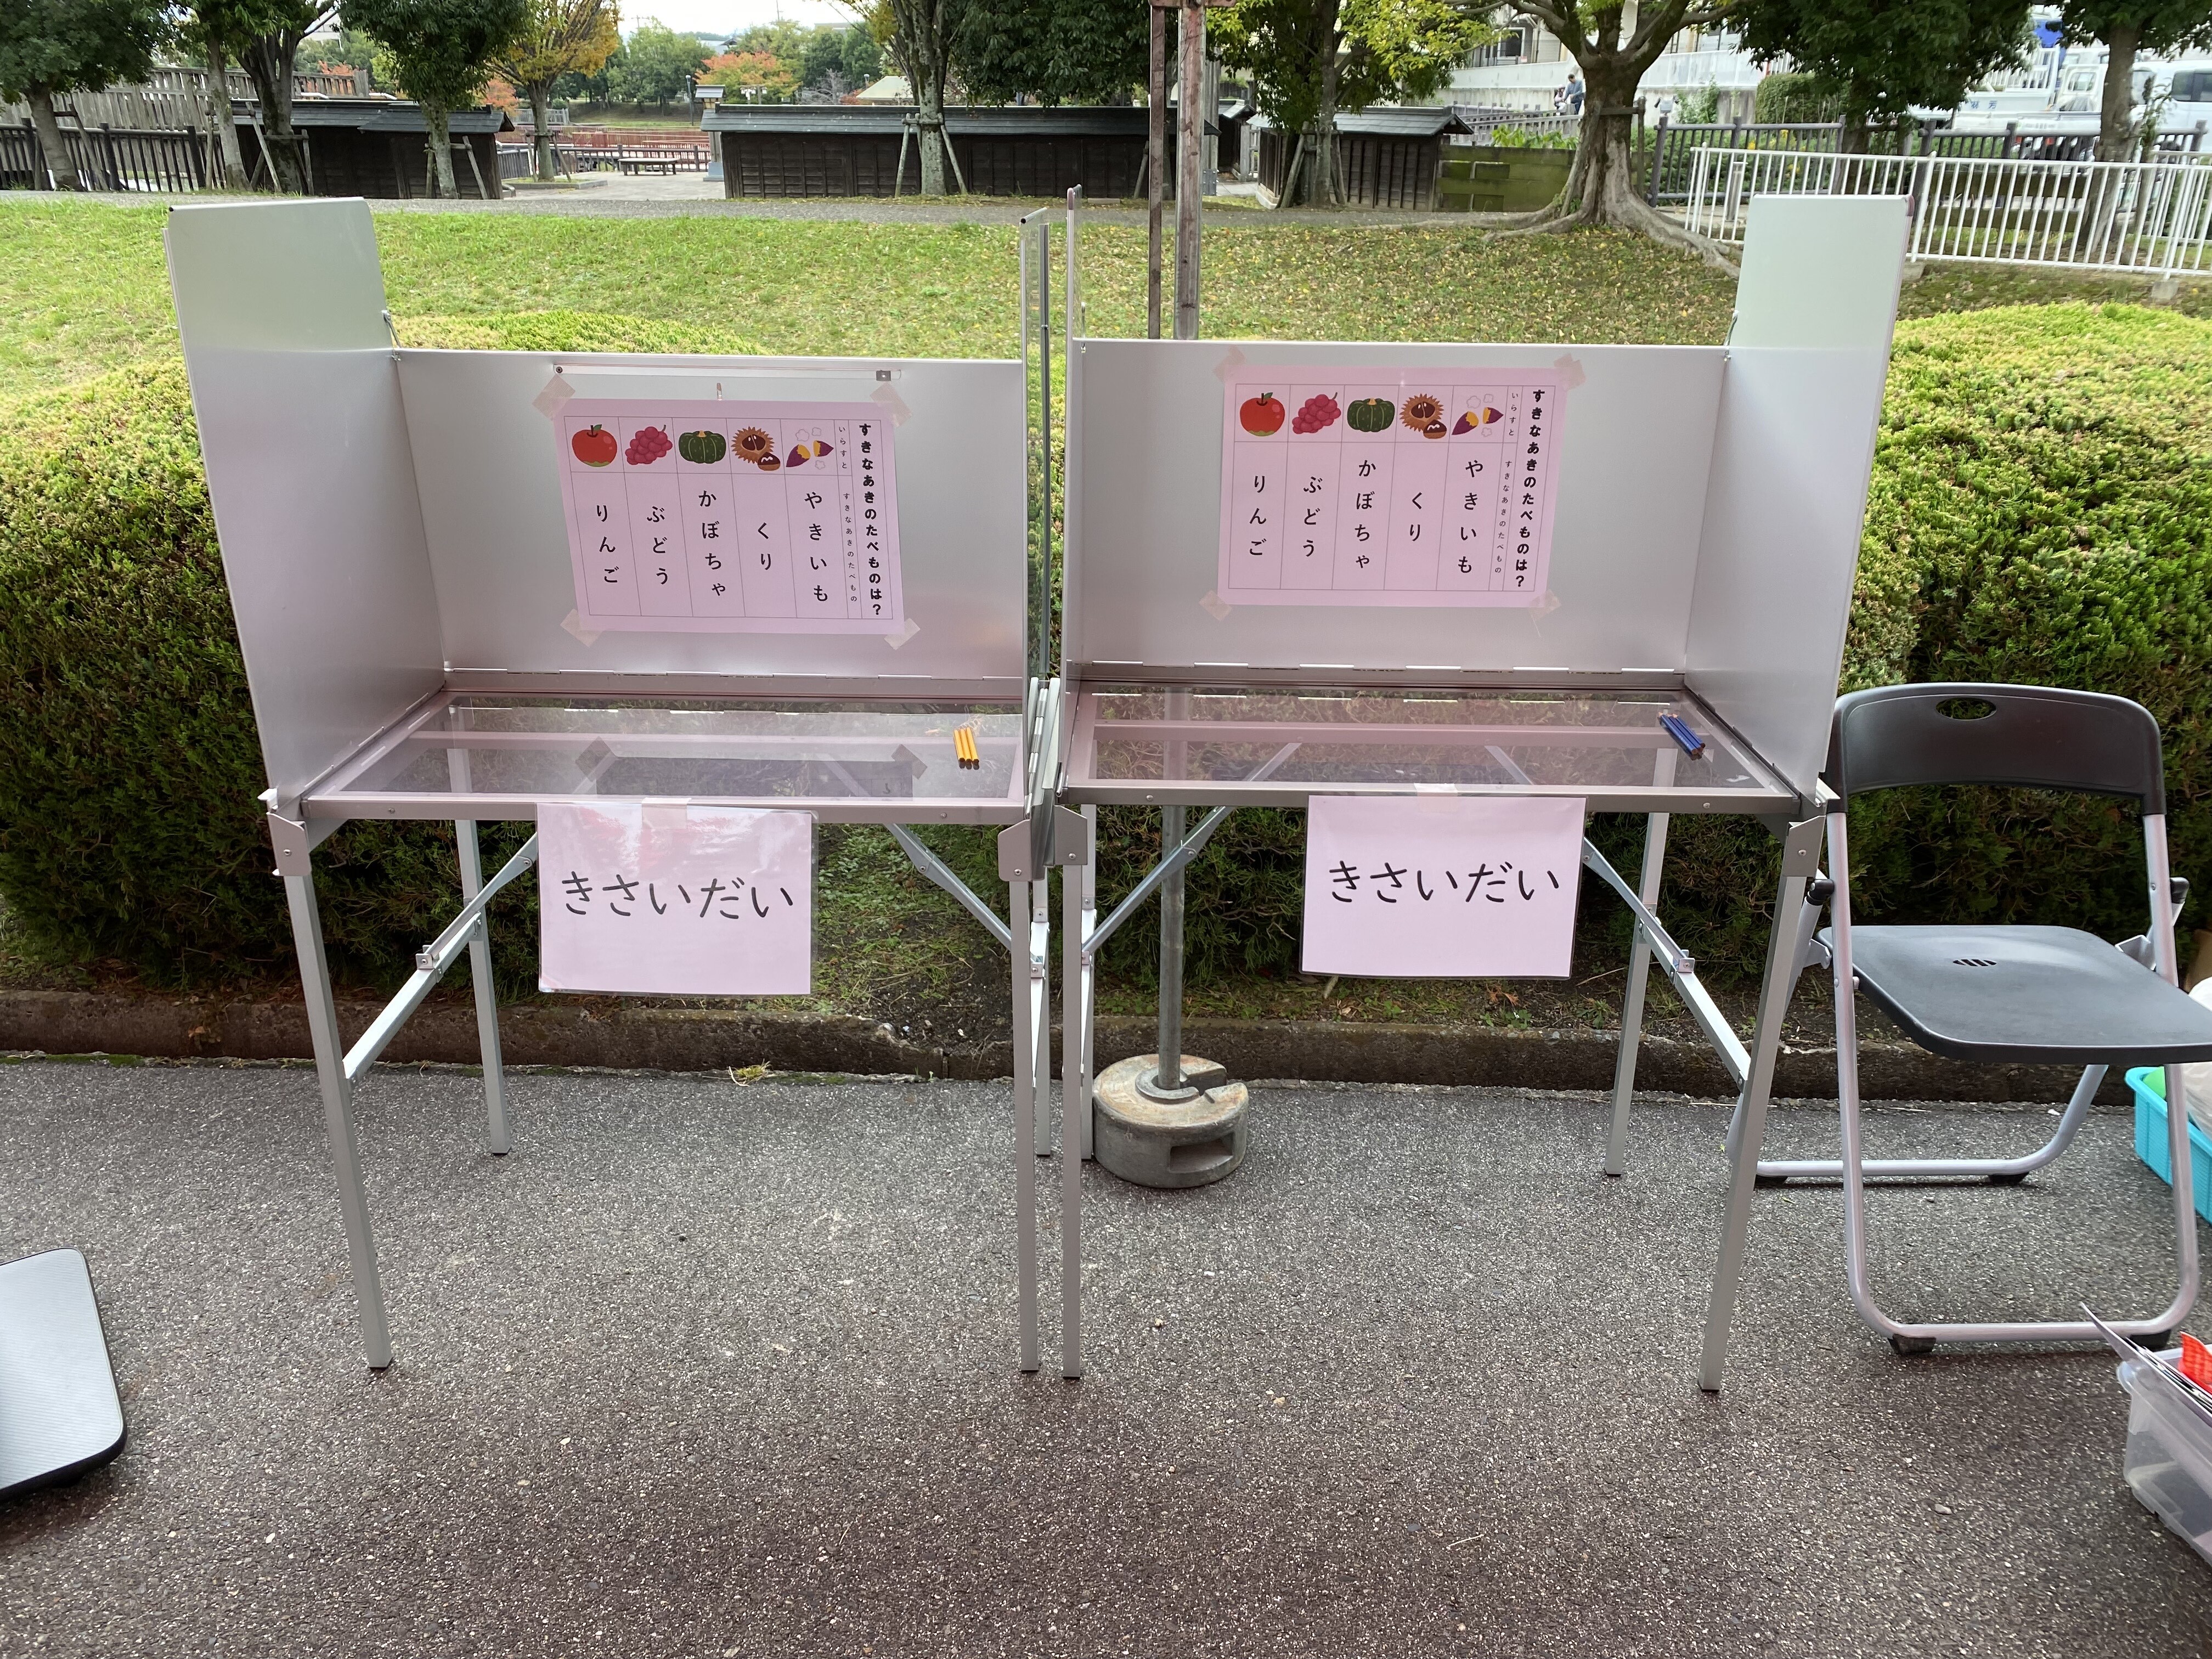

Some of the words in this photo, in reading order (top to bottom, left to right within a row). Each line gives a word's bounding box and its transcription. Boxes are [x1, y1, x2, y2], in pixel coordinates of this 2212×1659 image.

[838, 427, 847, 469] いらすと
[1509, 393, 1519, 436] いらすと
[859, 423, 882, 616] すきなあきのたべものは?
[1249, 476, 1267, 556] りんご
[1303, 476, 1323, 557] ぶどう
[1355, 459, 1376, 569] かぼちゃ
[1409, 492, 1423, 541] くり
[1458, 460, 1483, 573] やきいも
[1494, 460, 1513, 573] すきなあきのたべもの
[1515, 389, 1545, 587] すきなあきのたべものは?
[596, 505, 619, 583] りんご
[646, 506, 668, 585] ぶどう
[698, 490, 726, 596] かぼちゃ
[758, 522, 771, 571] くり
[804, 492, 828, 602] やきいも
[843, 493, 857, 602] すきなあきのたべもの
[561, 871, 793, 919] きさいだい
[1329, 860, 1559, 904] きさいだい
